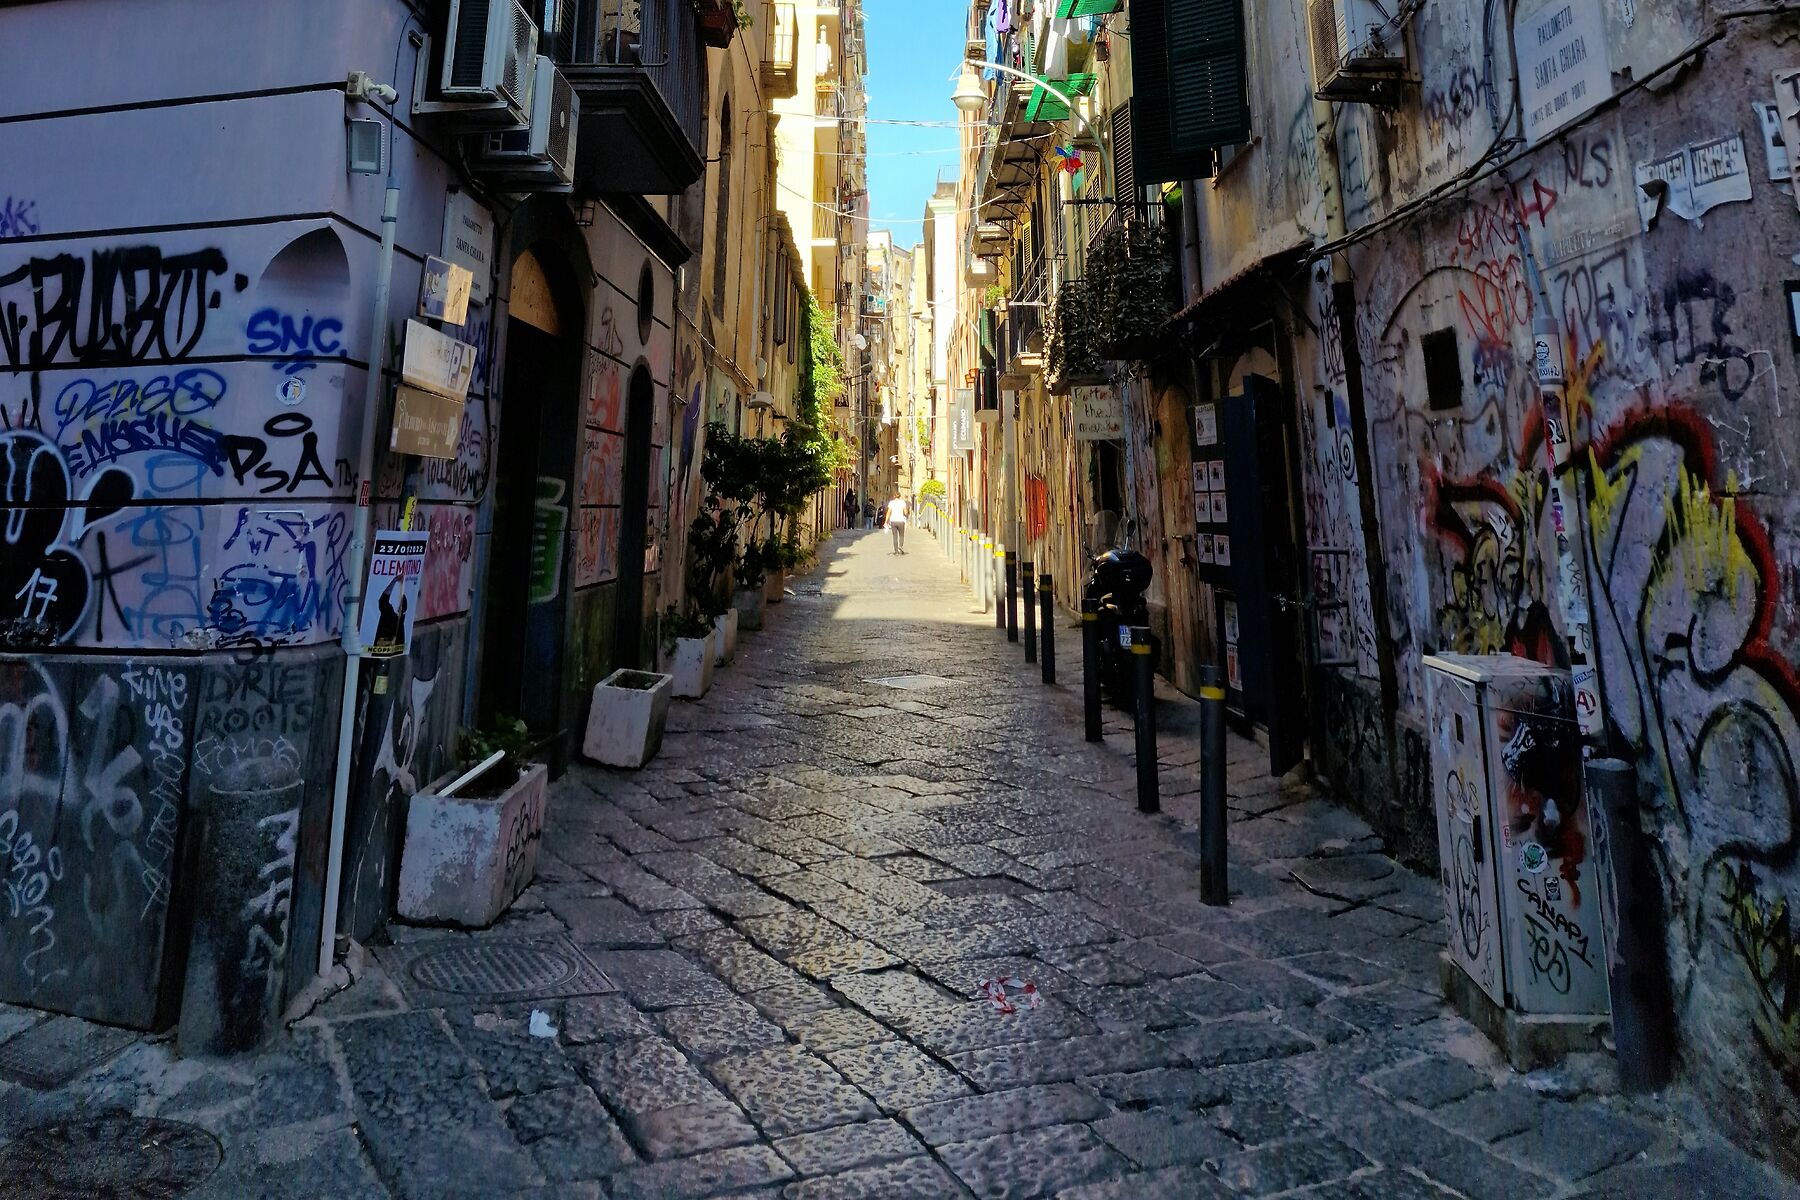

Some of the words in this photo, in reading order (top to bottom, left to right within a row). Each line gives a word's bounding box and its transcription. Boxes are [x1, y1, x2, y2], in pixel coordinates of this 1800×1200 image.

[1537, 5, 1573, 47] PALLONETTO
[1534, 55, 1558, 90] SANTA
[1559, 35, 1588, 73] CHIARA
[455, 237, 470, 256] SANTA
[469, 244, 485, 263] CHIARA
